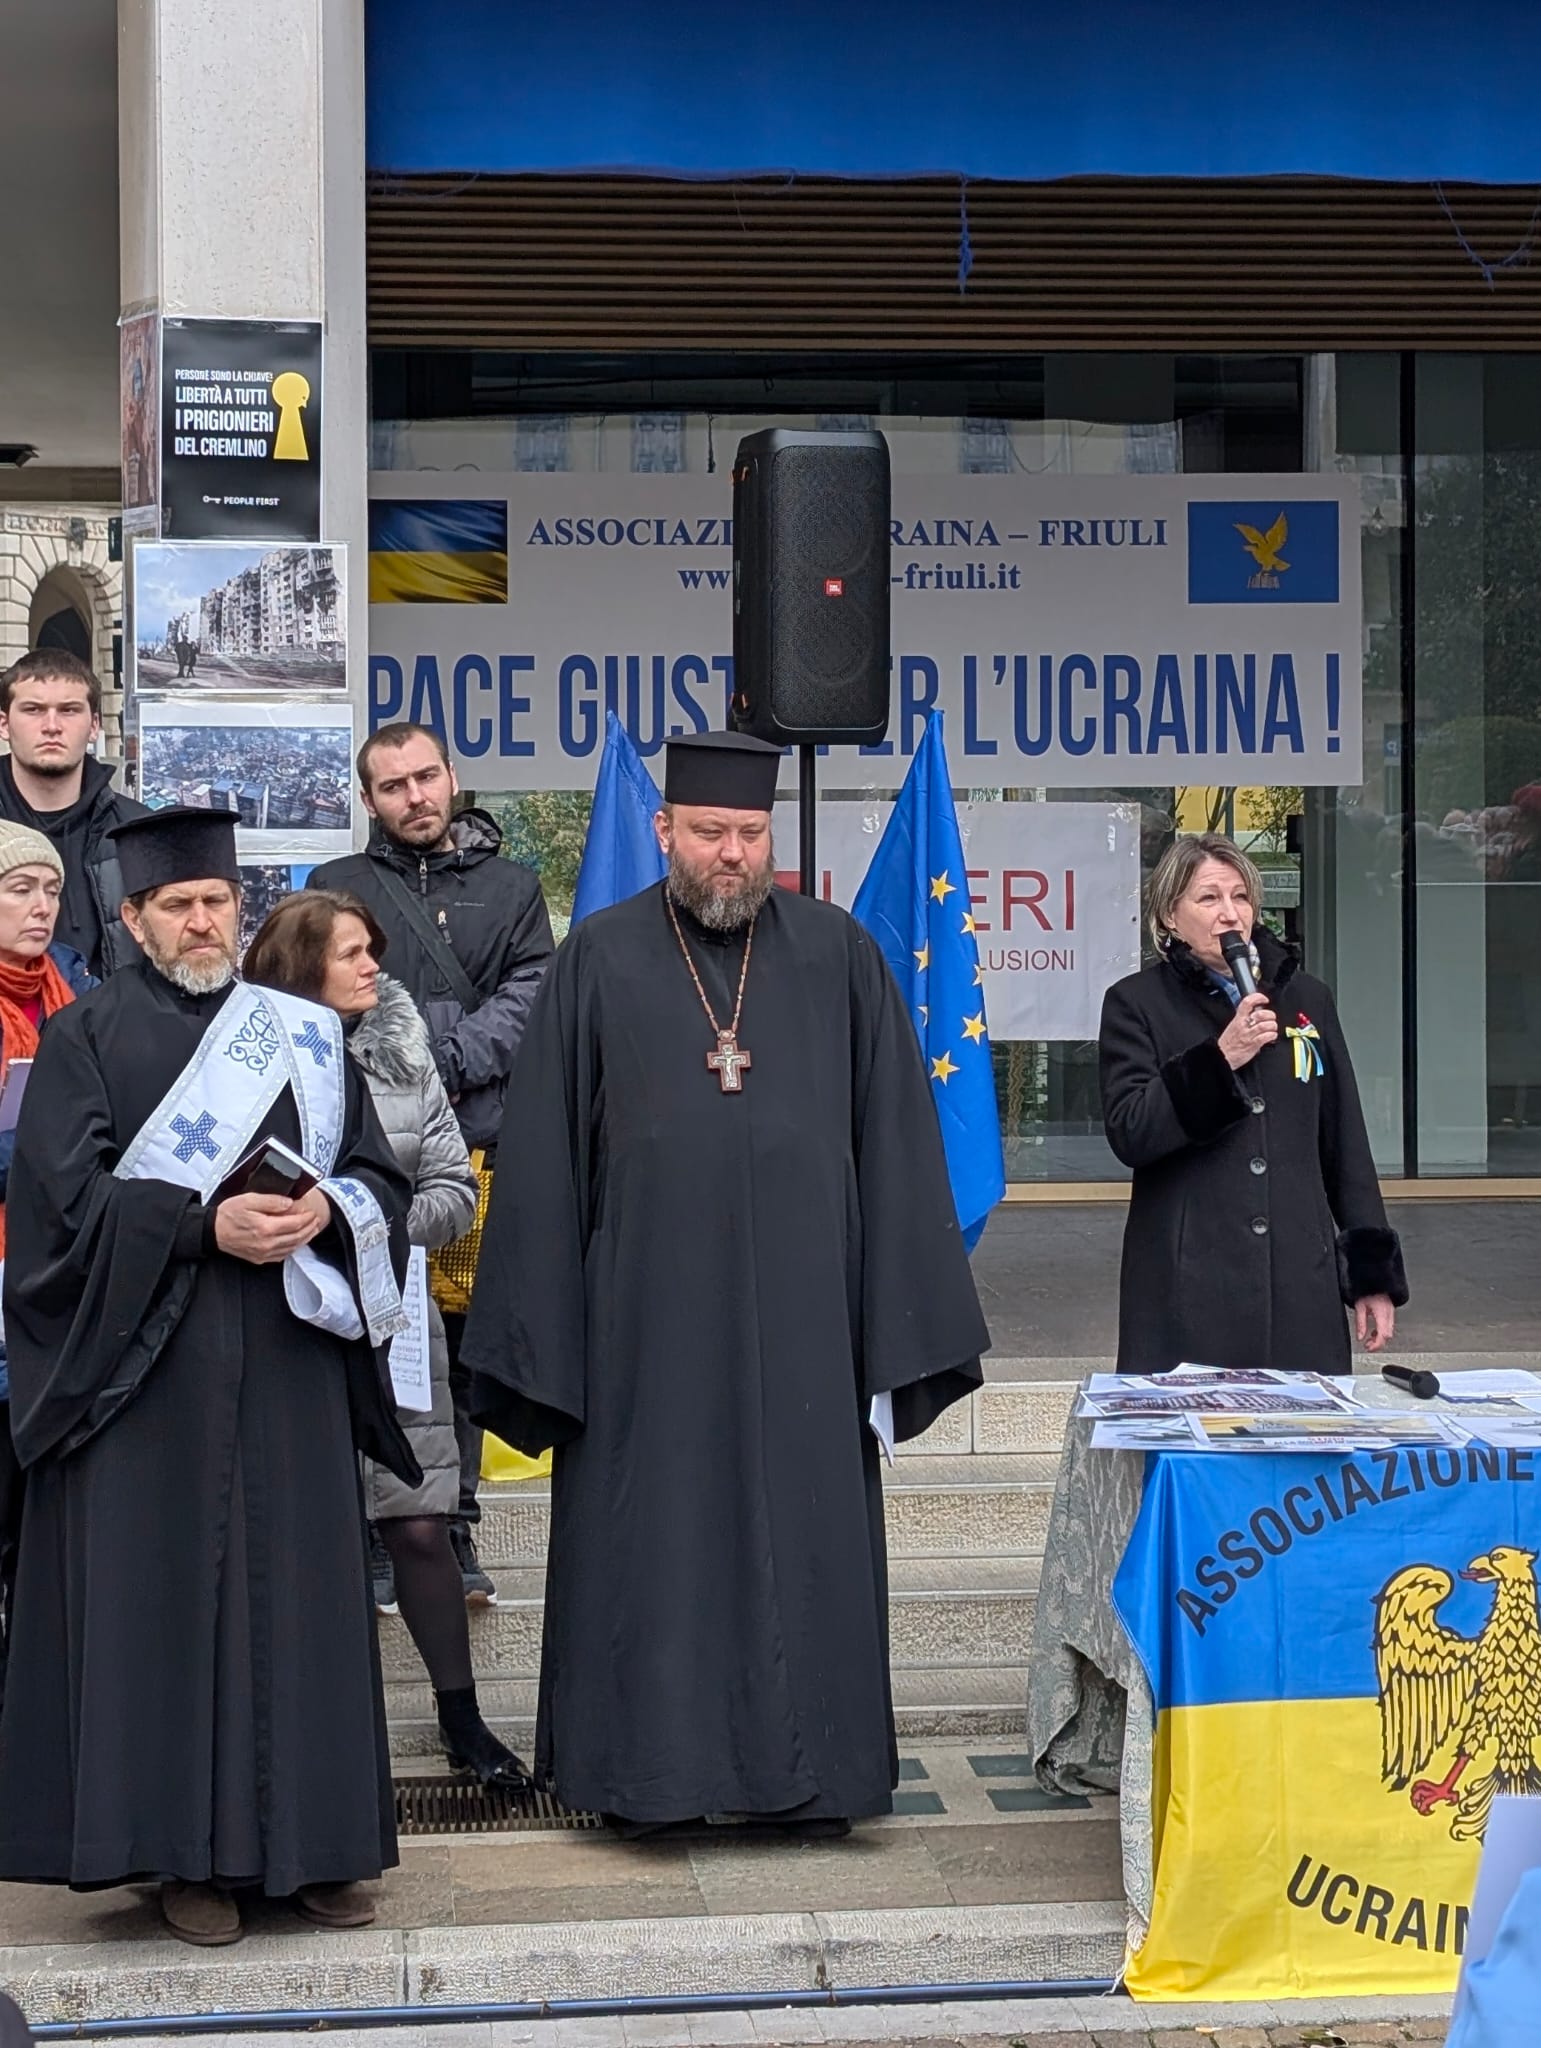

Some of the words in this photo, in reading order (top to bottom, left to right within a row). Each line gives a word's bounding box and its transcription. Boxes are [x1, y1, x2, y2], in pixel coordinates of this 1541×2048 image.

[210, 370, 232, 382] SONO
[232, 371, 243, 382] LA
[175, 384, 223, 404] LIBERTÀ
[223, 388, 233, 405] A
[234, 388, 268, 406] TUTTI
[175, 409, 181, 431] I
[183, 409, 274, 433] PRIGIONIERI
[174, 437, 199, 456] DEL
[200, 437, 268, 458] CREMLINO
[223, 496, 255, 506] PEOPLE
[526, 518, 733, 546] ASSOCIAZI
[889, 519, 1001, 546] RAINA
[1038, 519, 1168, 546] FRIULI
[368, 654, 535, 757] PACE
[558, 654, 733, 757] GIUST
[1176, 1447, 1534, 1637] ASSOCIAZIONE
